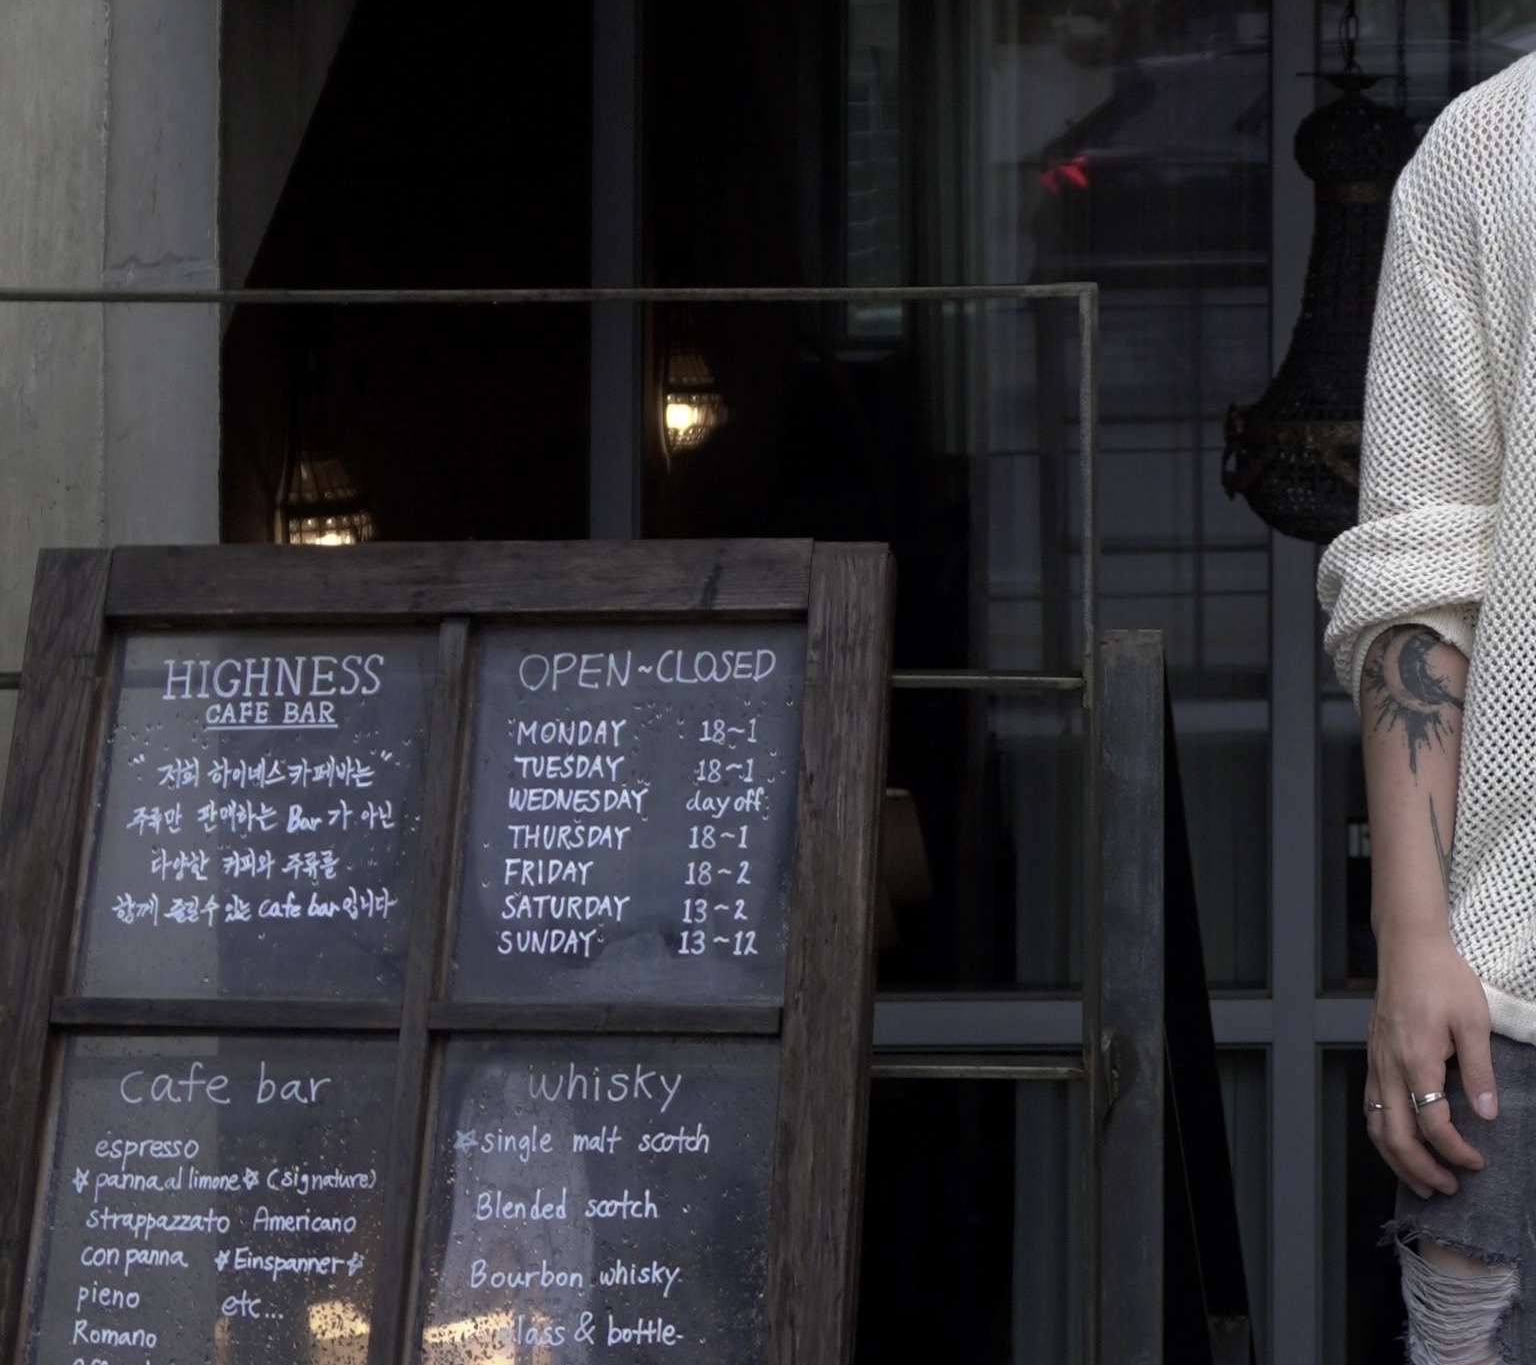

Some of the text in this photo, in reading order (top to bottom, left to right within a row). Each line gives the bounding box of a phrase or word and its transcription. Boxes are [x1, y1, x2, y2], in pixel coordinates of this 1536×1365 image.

[162, 653, 386, 701] HIGHNESS
[205, 700, 336, 725] CAFE BAR
[517, 719, 626, 747] MONDAY
[513, 755, 624, 782] TUESDAY
[197, 799, 278, 832] 판매하는
[361, 800, 395, 830] 아닌
[508, 786, 765, 819] WEDNESDAY day off
[507, 825, 631, 850] THURSDAY
[151, 847, 210, 881] 다양한
[222, 847, 275, 880] 커피와
[503, 858, 594, 887] FRIDAY
[258, 890, 301, 918] cafe
[501, 894, 631, 922] SATURDAY
[497, 928, 598, 957] SUNDAY
[256, 1061, 331, 1105] bar
[528, 1062, 682, 1113] whisky
[95, 1138, 200, 1170] espresso
[480, 1123, 710, 1163] single malt scotch
[95, 1171, 165, 1202] panna
[476, 1187, 659, 1220] Blended scotch
[85, 1205, 356, 1240] strappazzato Americano
[81, 1246, 344, 1282] con panna Einspanner
[470, 1258, 680, 1298] Bourbon whisky
[77, 1281, 140, 1312] pieno
[72, 1319, 157, 1349] Romano
[573, 1311, 596, 1346] &
[607, 1314, 677, 1347] bottle
